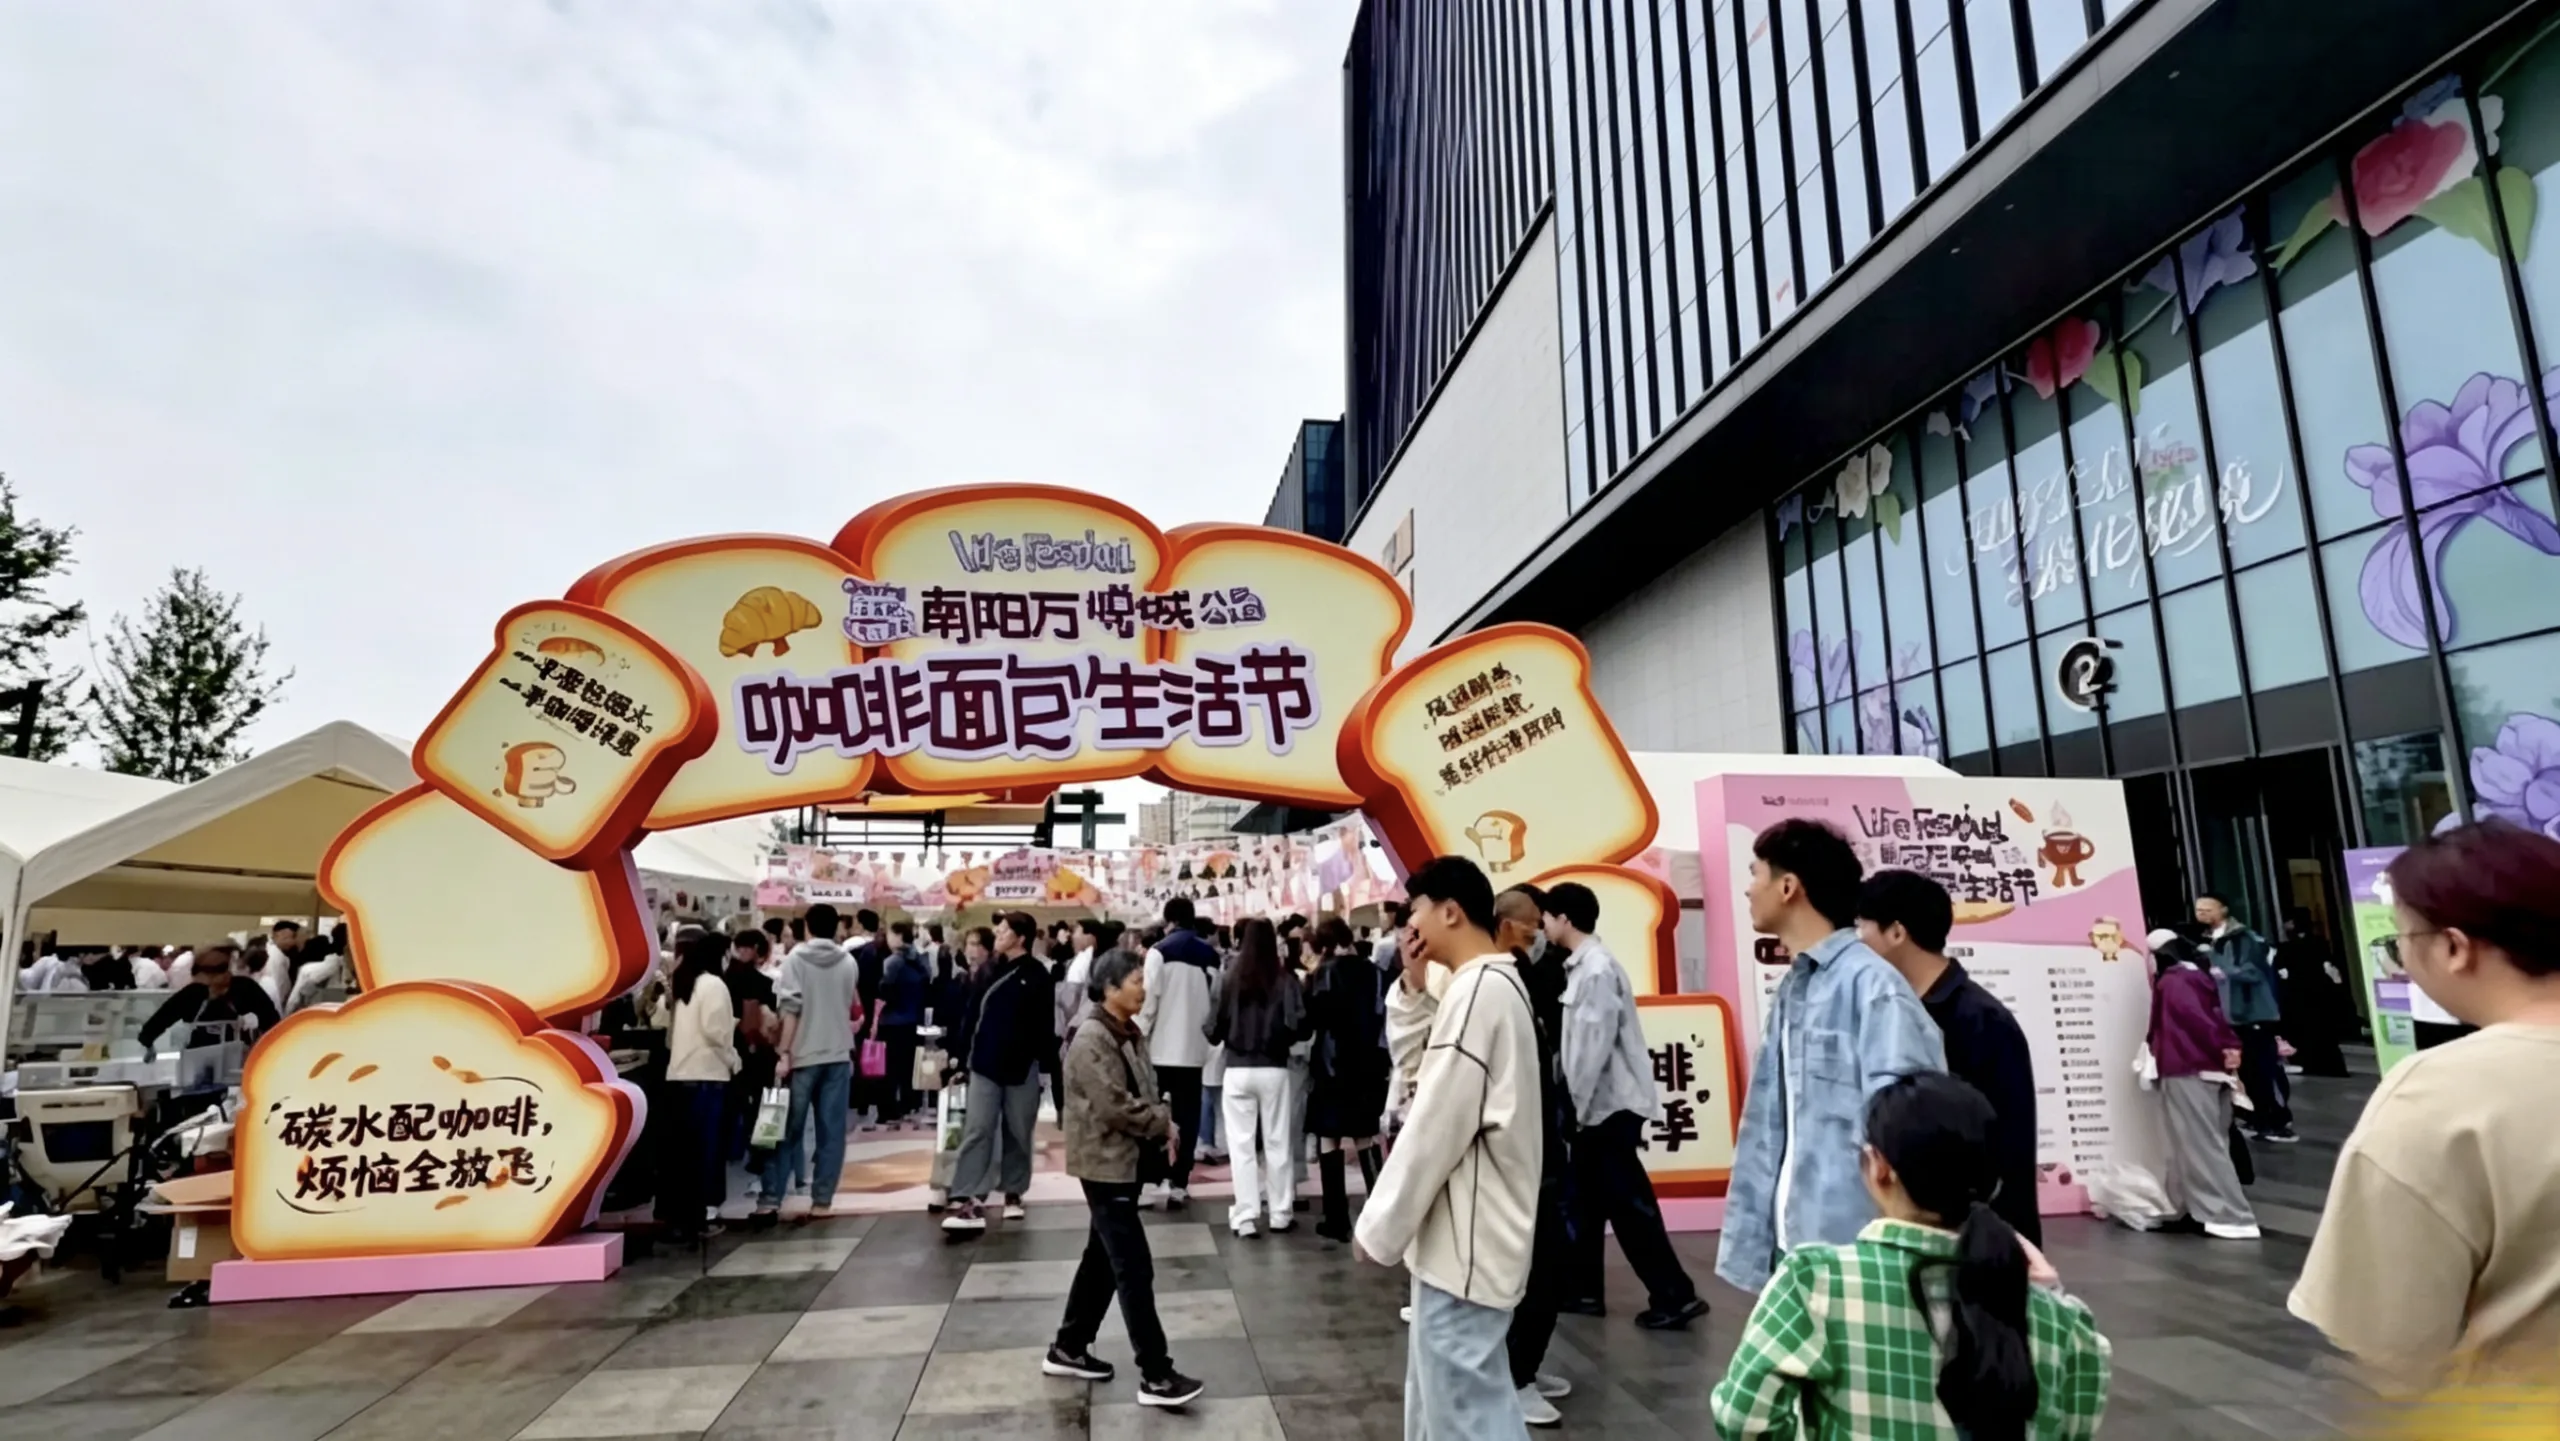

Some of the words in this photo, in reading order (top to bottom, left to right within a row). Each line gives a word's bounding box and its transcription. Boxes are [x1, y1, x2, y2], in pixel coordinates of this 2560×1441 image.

[741, 644, 1313, 766] 咖啡面包生活节
[278, 1094, 554, 1151] 碳水配咖啡,
[294, 1146, 540, 1202] 烦恼全放飞
